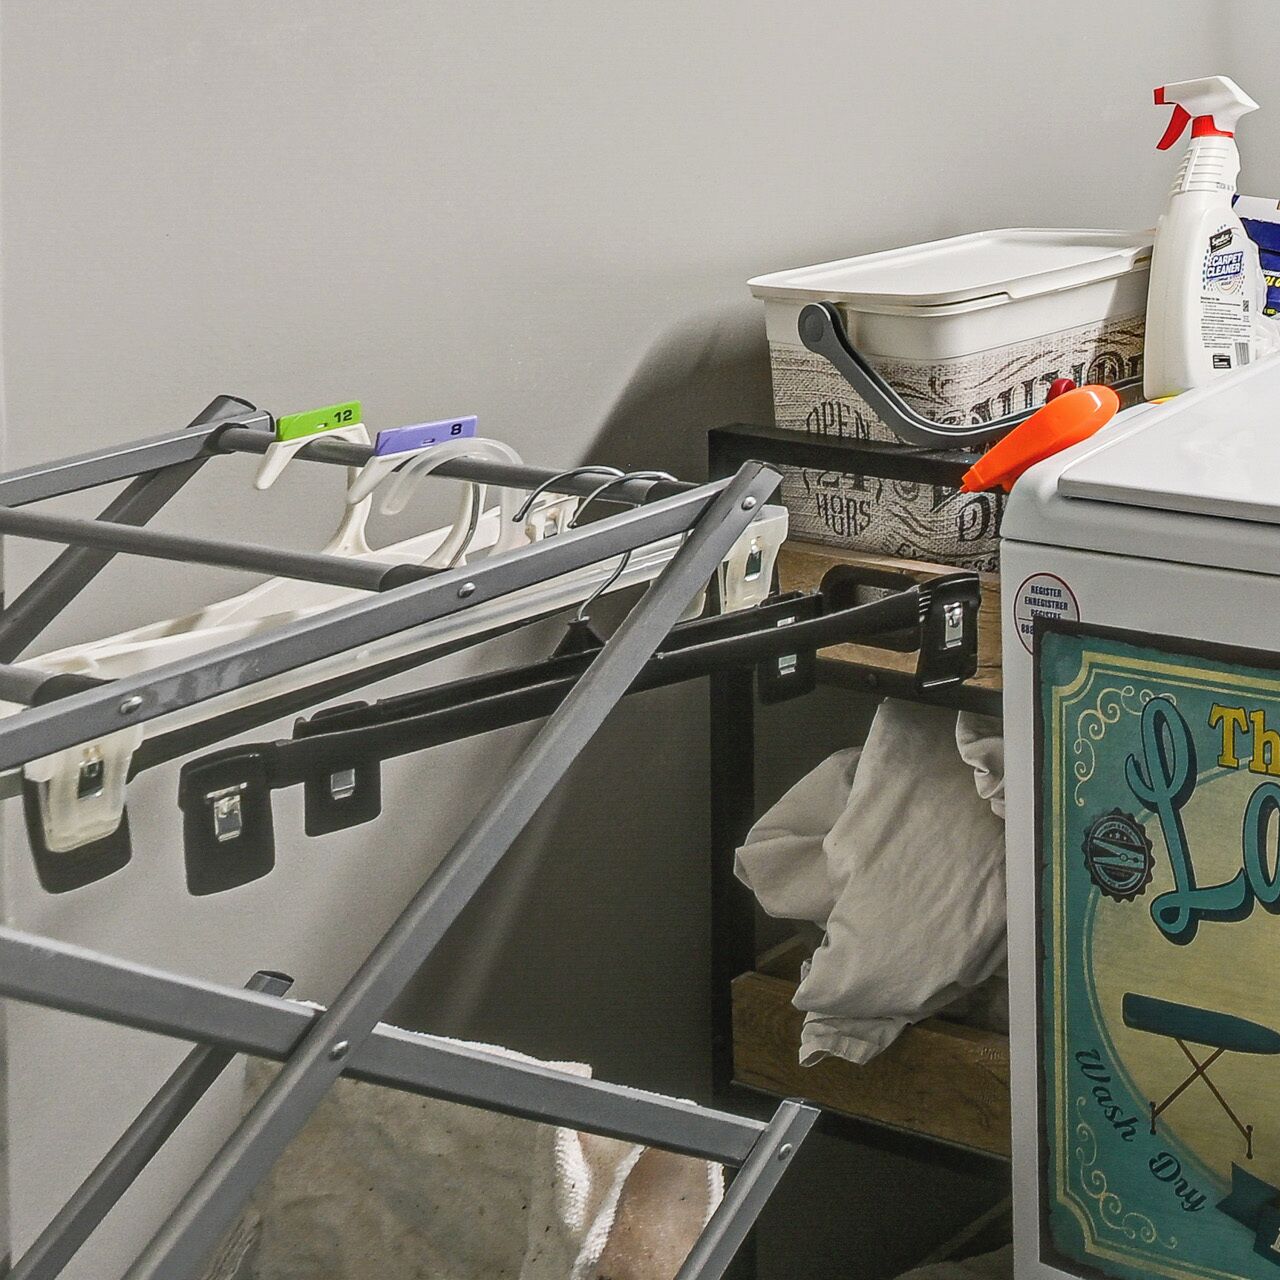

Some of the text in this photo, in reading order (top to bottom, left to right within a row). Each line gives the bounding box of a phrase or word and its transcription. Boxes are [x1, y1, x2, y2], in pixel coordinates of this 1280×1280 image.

[1212, 252, 1243, 267] CARPET
[1207, 262, 1241, 278] CLEANER
[333, 409, 353, 423] 12
[450, 423, 463, 436] 8
[1030, 585, 1062, 598] REGISTER
[1024, 596, 1069, 611] ENREGISTRER
[1075, 1048, 1138, 1143] Wash
[1149, 1151, 1208, 1212] Dry
